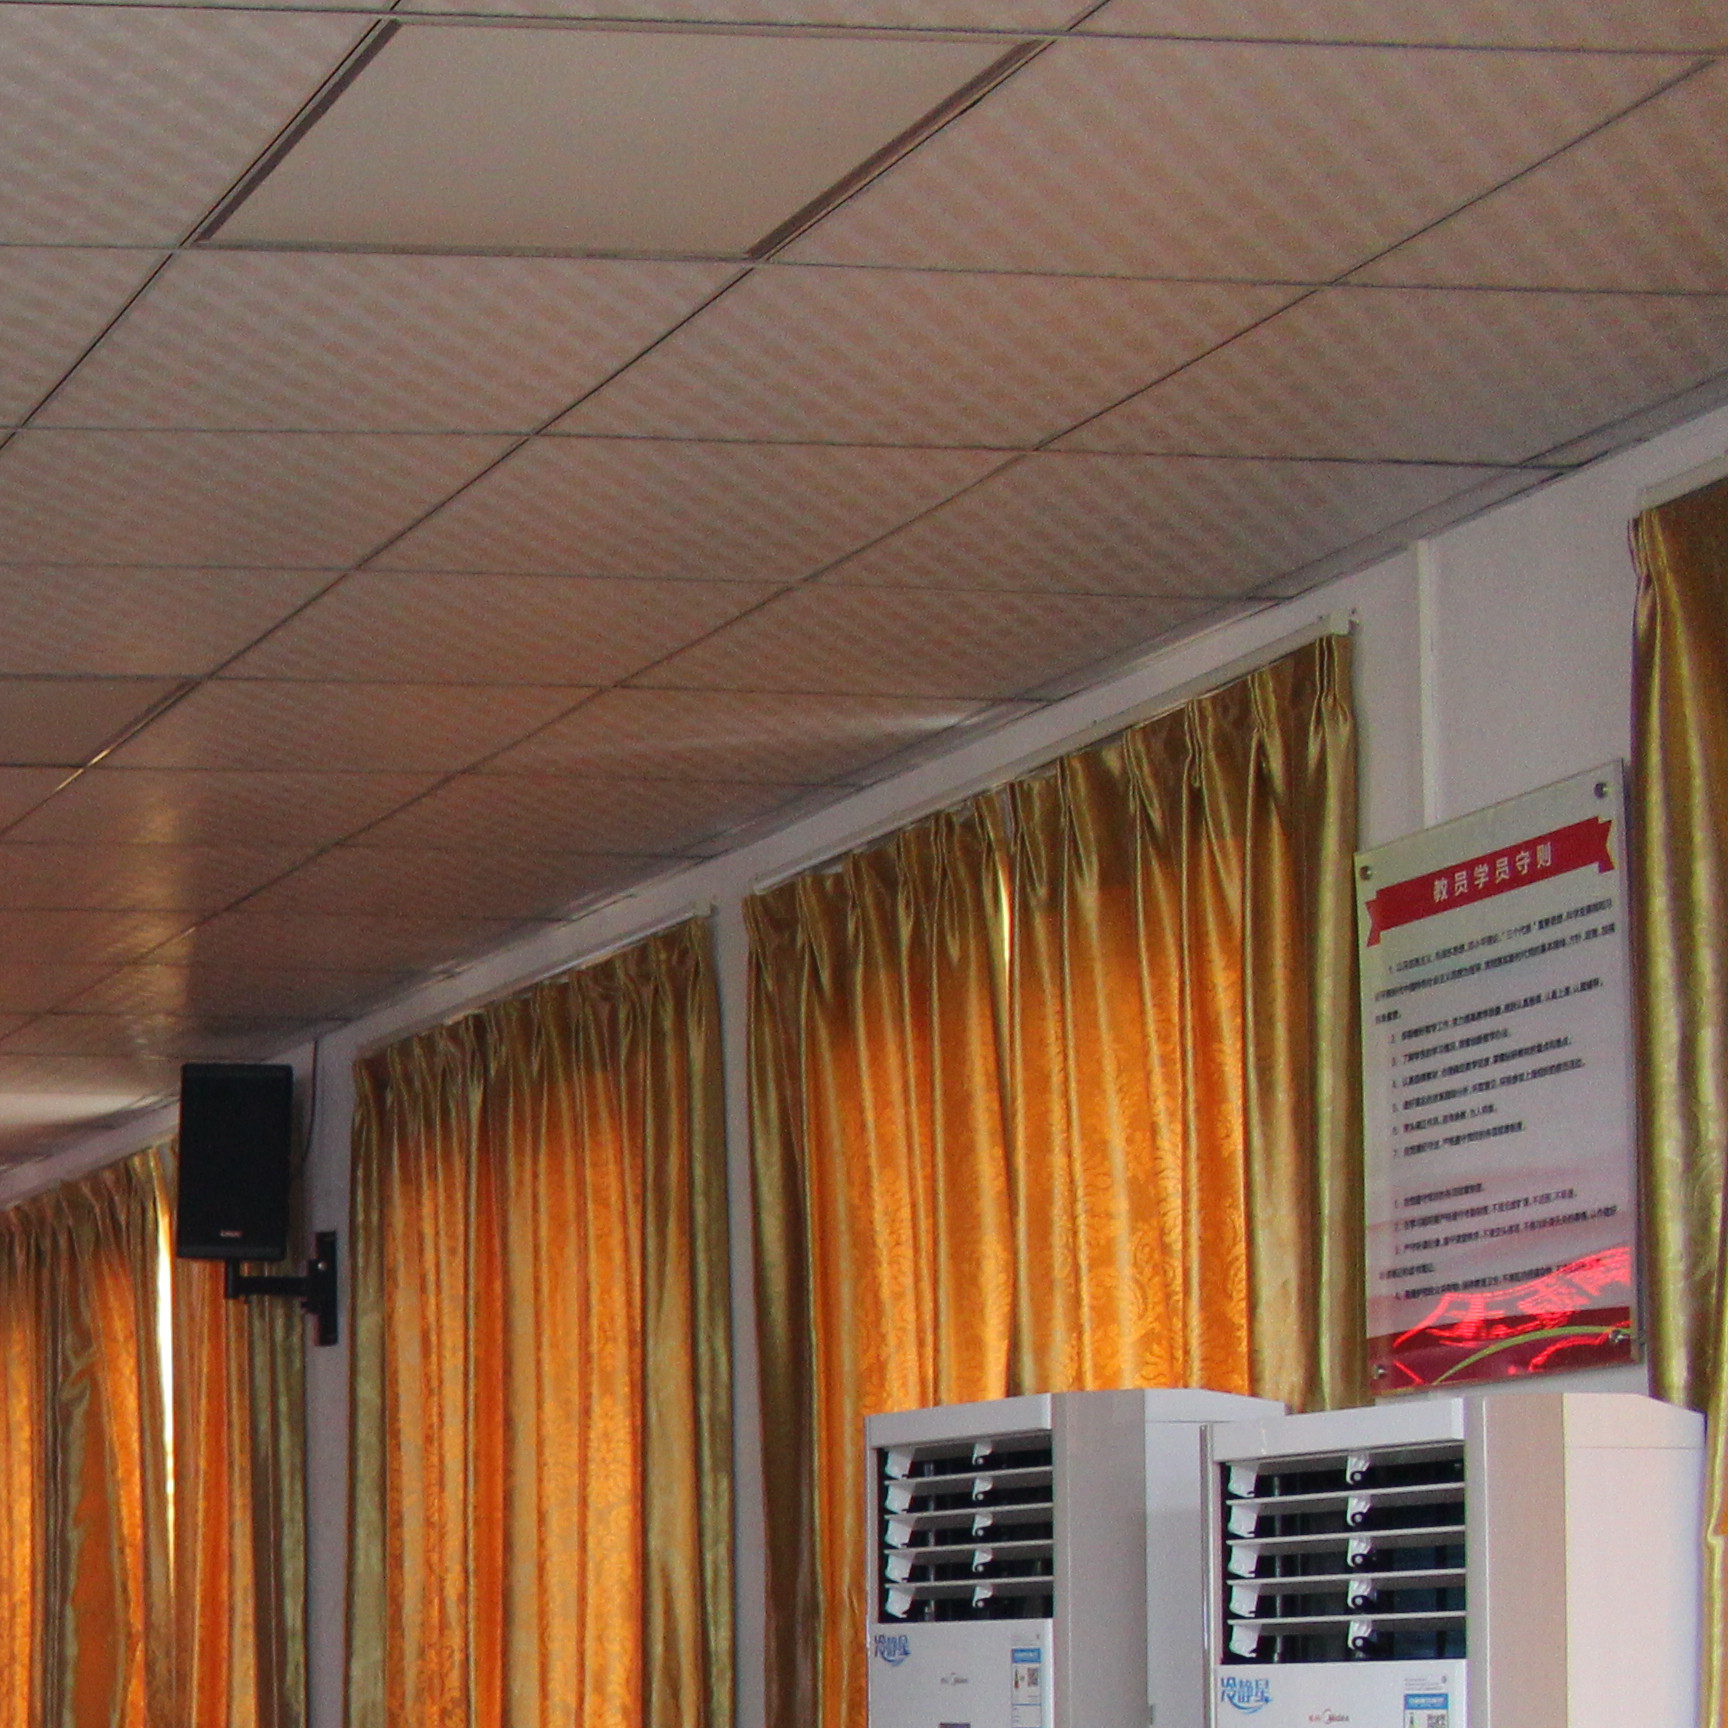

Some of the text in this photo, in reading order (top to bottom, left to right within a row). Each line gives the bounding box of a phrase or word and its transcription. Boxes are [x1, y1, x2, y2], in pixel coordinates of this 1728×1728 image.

[1433, 841, 1553, 904] 教员学员守则
